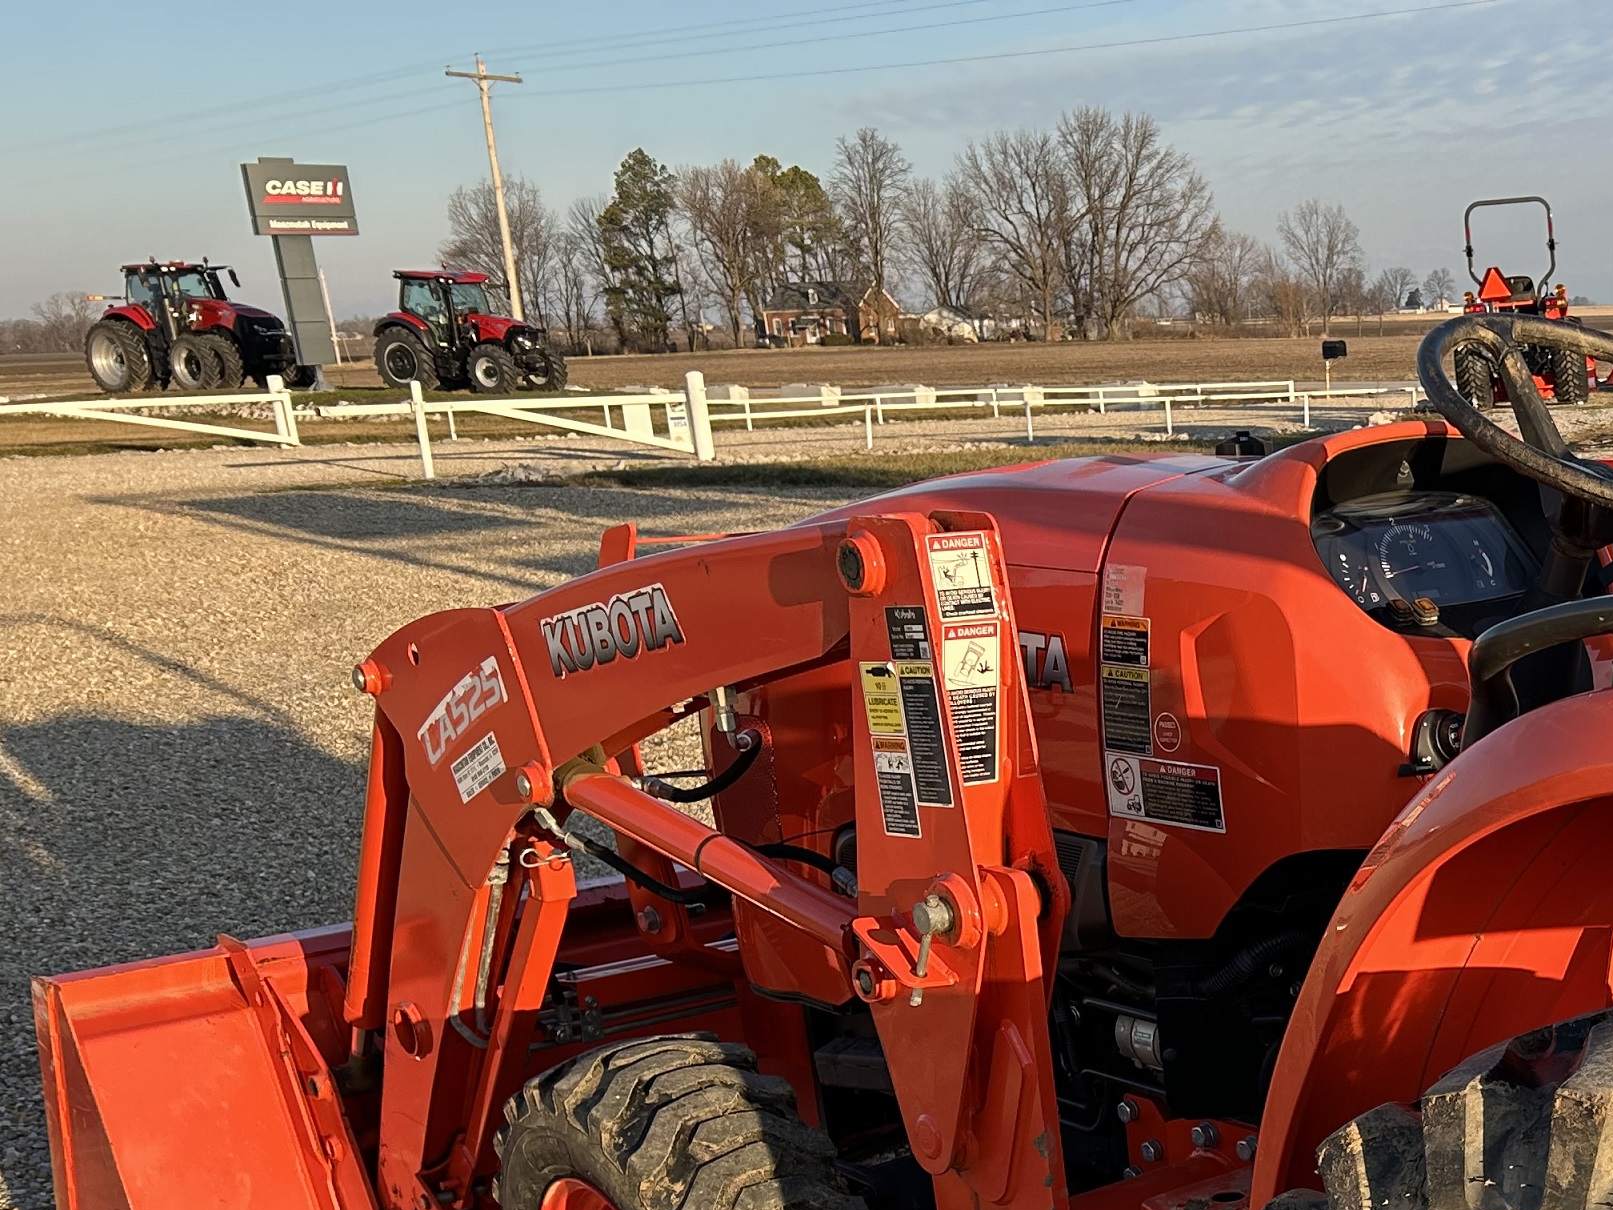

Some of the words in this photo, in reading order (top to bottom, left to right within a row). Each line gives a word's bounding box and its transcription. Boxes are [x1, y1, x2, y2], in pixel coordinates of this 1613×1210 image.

[266, 180, 324, 195] CASE
[311, 220, 348, 230] Equipment
[1388, 518, 1396, 526] 2
[1423, 524, 1430, 532] 3
[942, 538, 980, 548] DANGER
[1117, 620, 1140, 628] WARNING
[541, 587, 685, 678] KUBOTA
[958, 626, 994, 636] DANGER
[905, 666, 930, 675] CAUTION
[1115, 671, 1143, 680] CAUTION
[868, 698, 898, 706] LUBRICATE
[420, 666, 501, 765] LA525
[880, 741, 905, 750] WARNING
[1168, 766, 1196, 776] DANGER
